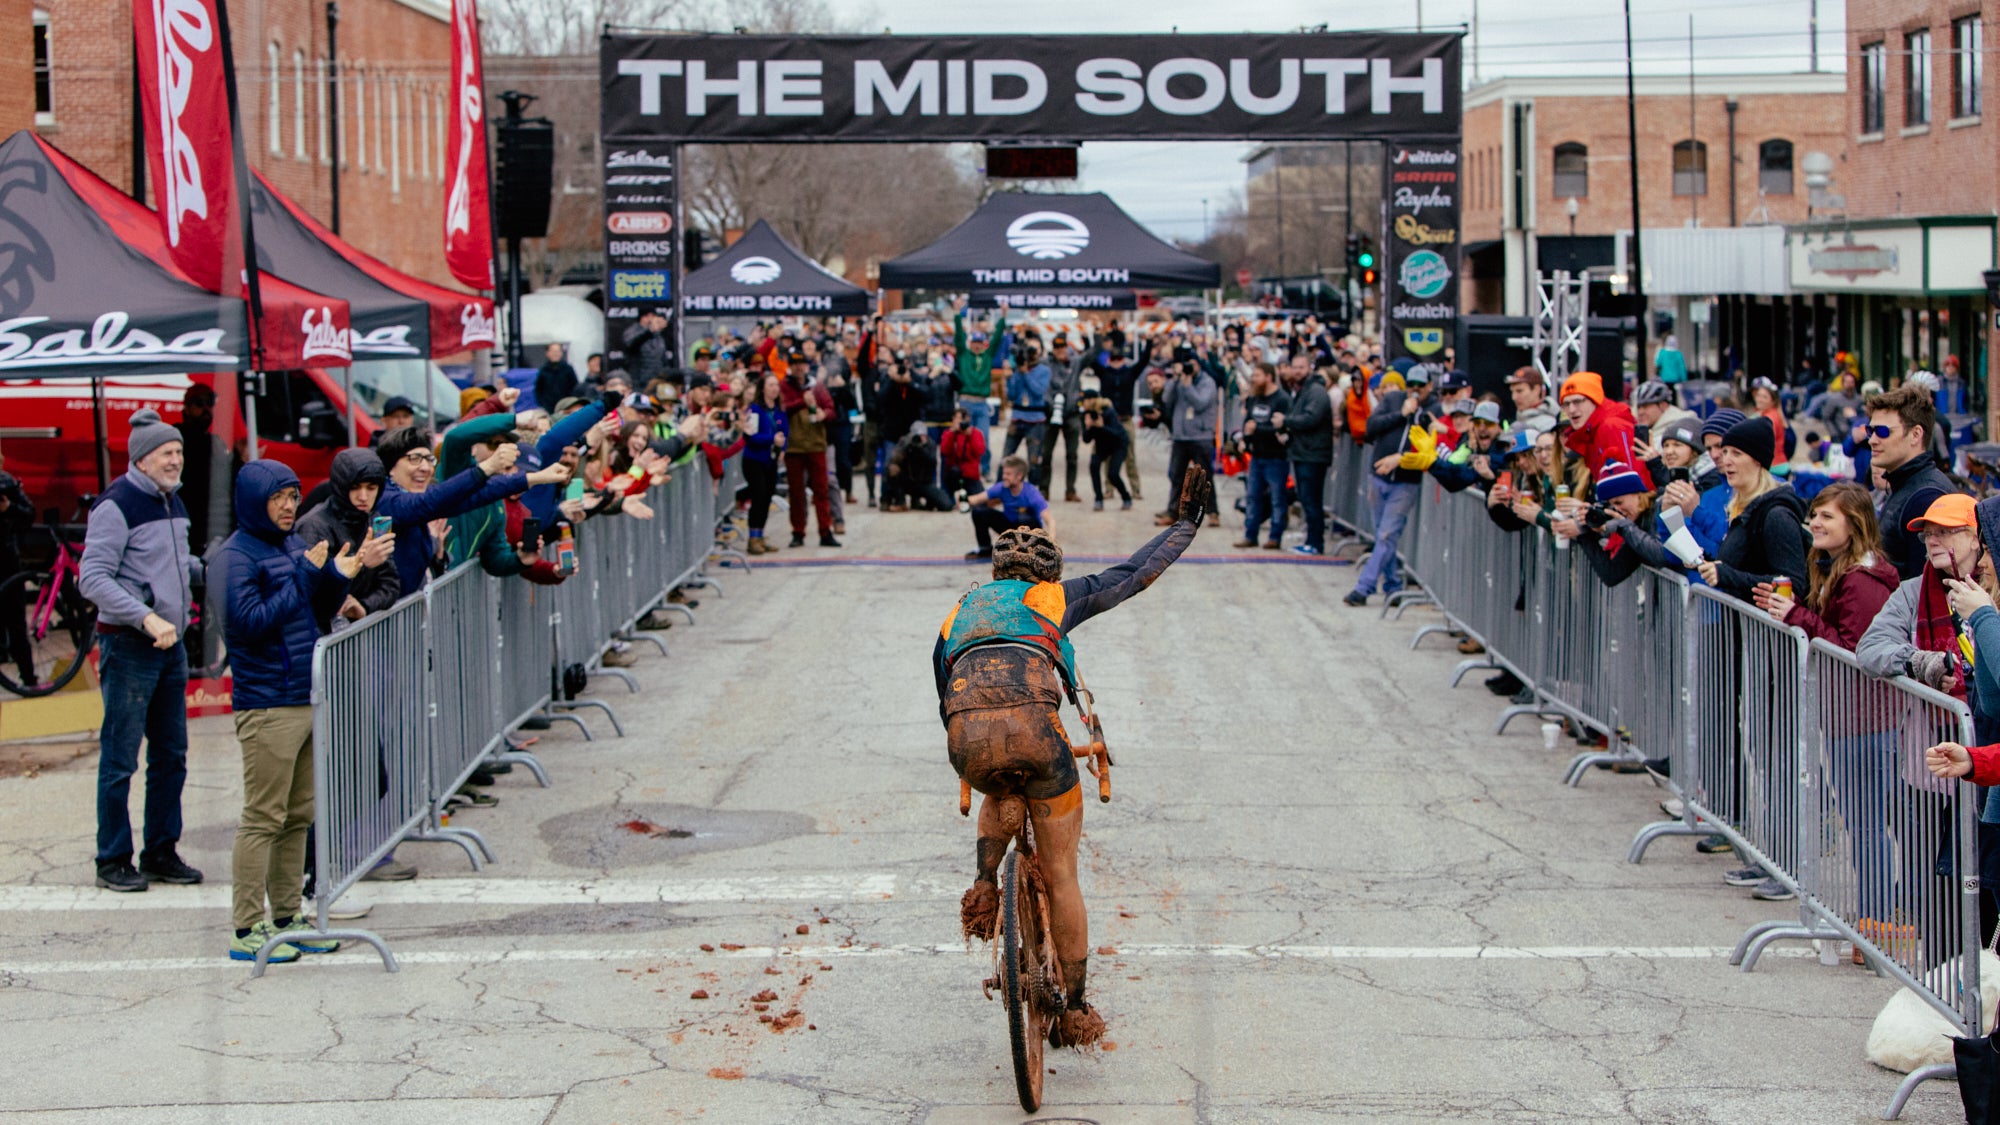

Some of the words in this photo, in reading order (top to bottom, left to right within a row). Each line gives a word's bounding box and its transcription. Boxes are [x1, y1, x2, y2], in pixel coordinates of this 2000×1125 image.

[618, 59, 824, 116] THE
[854, 59, 1048, 116] MID
[1075, 57, 1443, 115] SOUTH
[1394, 186, 1452, 214] Rapha
[609, 240, 671, 255] BROOKS
[972, 269, 1013, 283] THE
[1016, 269, 1055, 283] MID
[1057, 268, 1129, 282] SOUTH
[683, 295, 713, 310] HE
[716, 295, 757, 310] MID
[758, 295, 832, 310] SOUTH
[994, 294, 1025, 307] THE
[1027, 295, 1057, 307] MID
[1058, 295, 1112, 307] SOUTH
[1392, 303, 1450, 319] skratch
[0, 311, 240, 370] Salsa
[301, 306, 353, 361] Salsa
